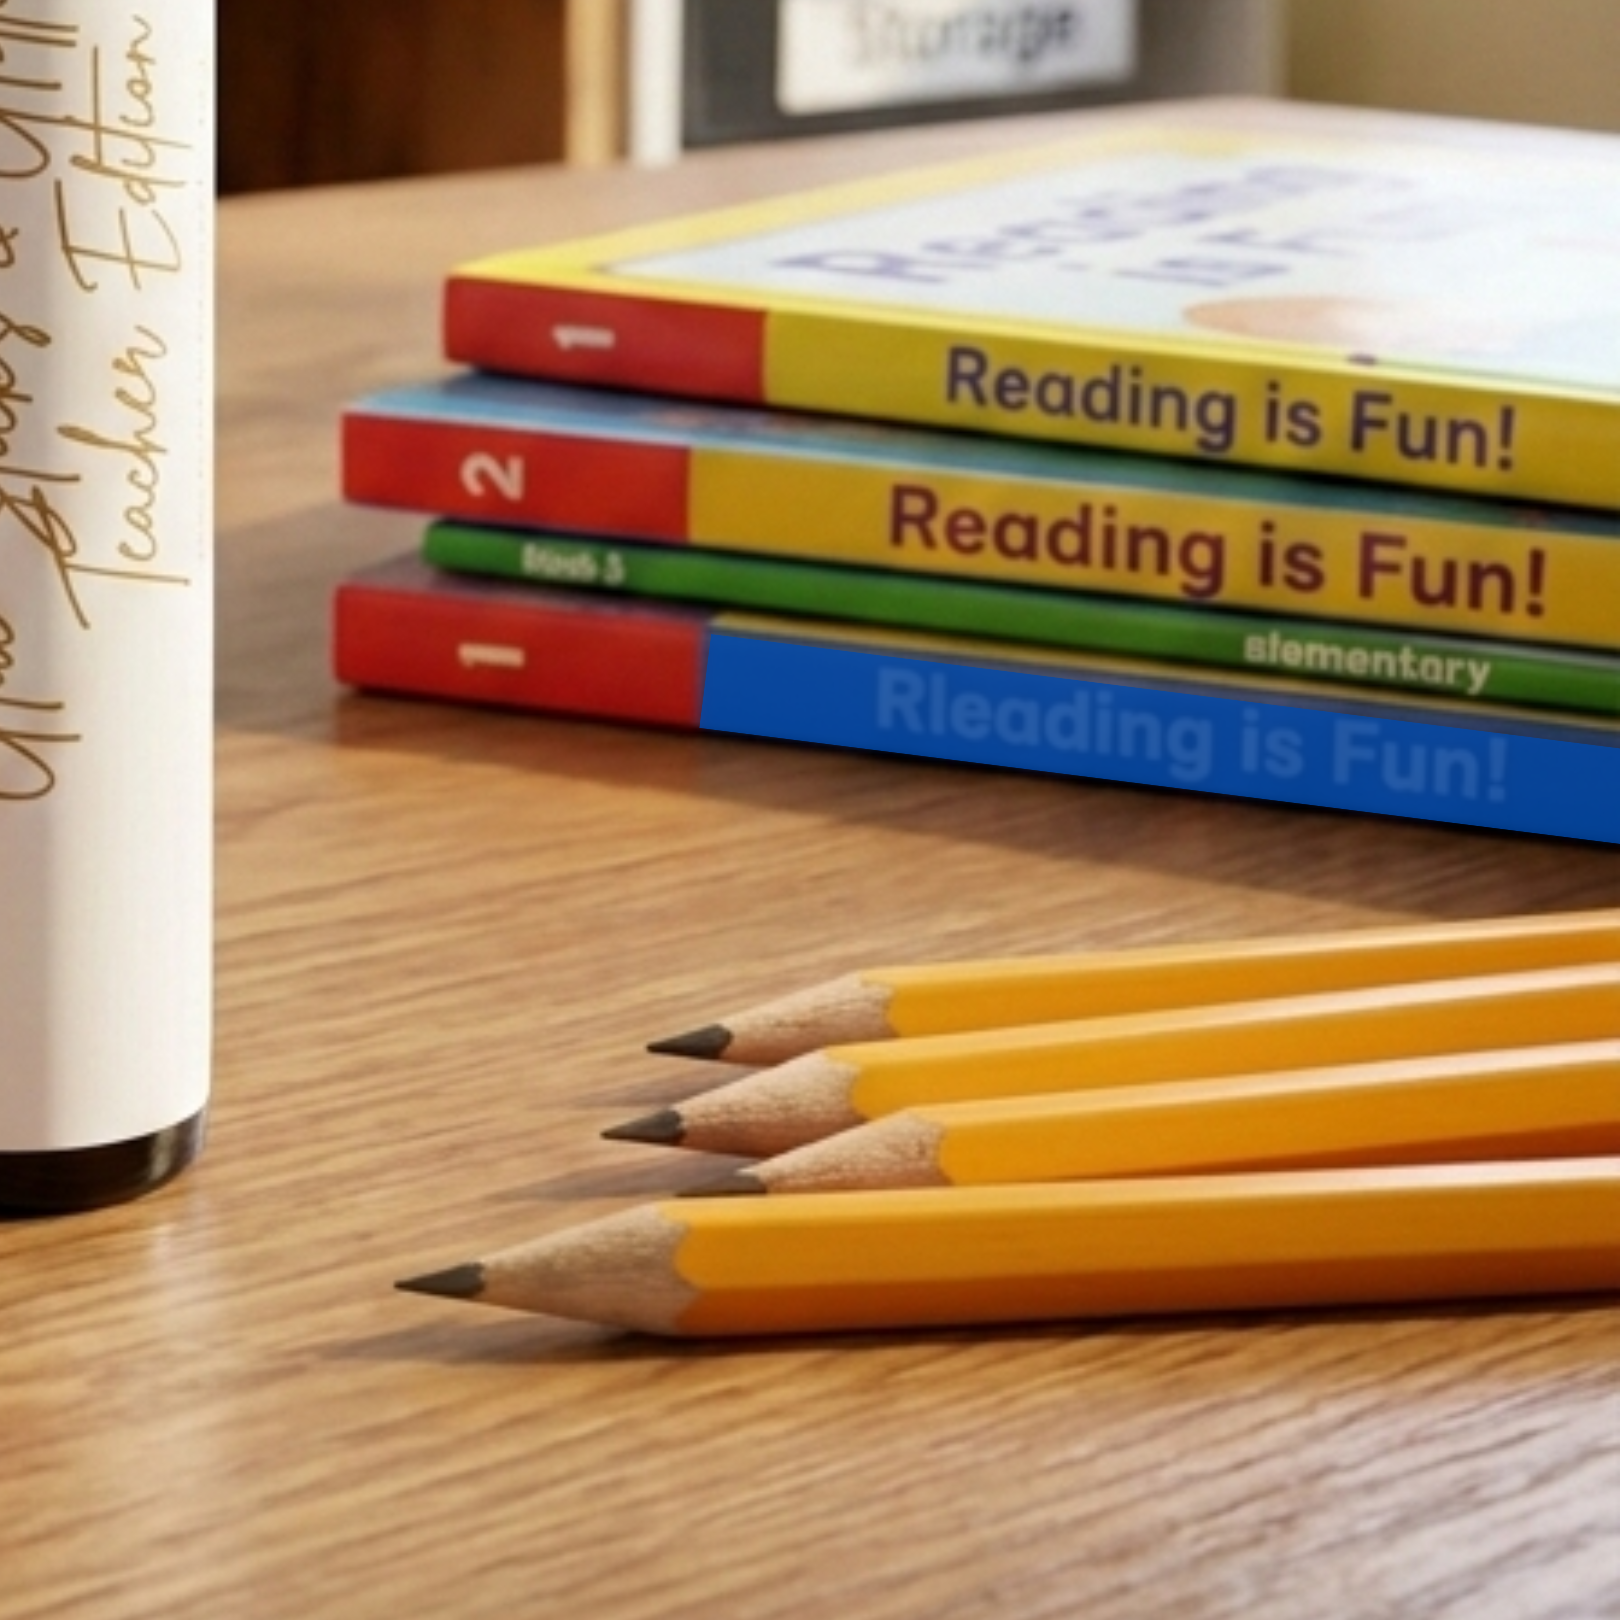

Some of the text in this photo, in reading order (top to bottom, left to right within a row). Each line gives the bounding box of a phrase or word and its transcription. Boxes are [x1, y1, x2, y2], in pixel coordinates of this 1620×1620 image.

[32, 14, 192, 631] Teacher Edition
[552, 326, 614, 348] 1
[945, 345, 1516, 473] Reading is Fun!
[461, 453, 523, 500] 2
[888, 483, 1546, 620] Reading is Fun!
[458, 643, 524, 667] 1
[1241, 707, 1304, 777] is
[1333, 718, 1507, 801] Fun!
